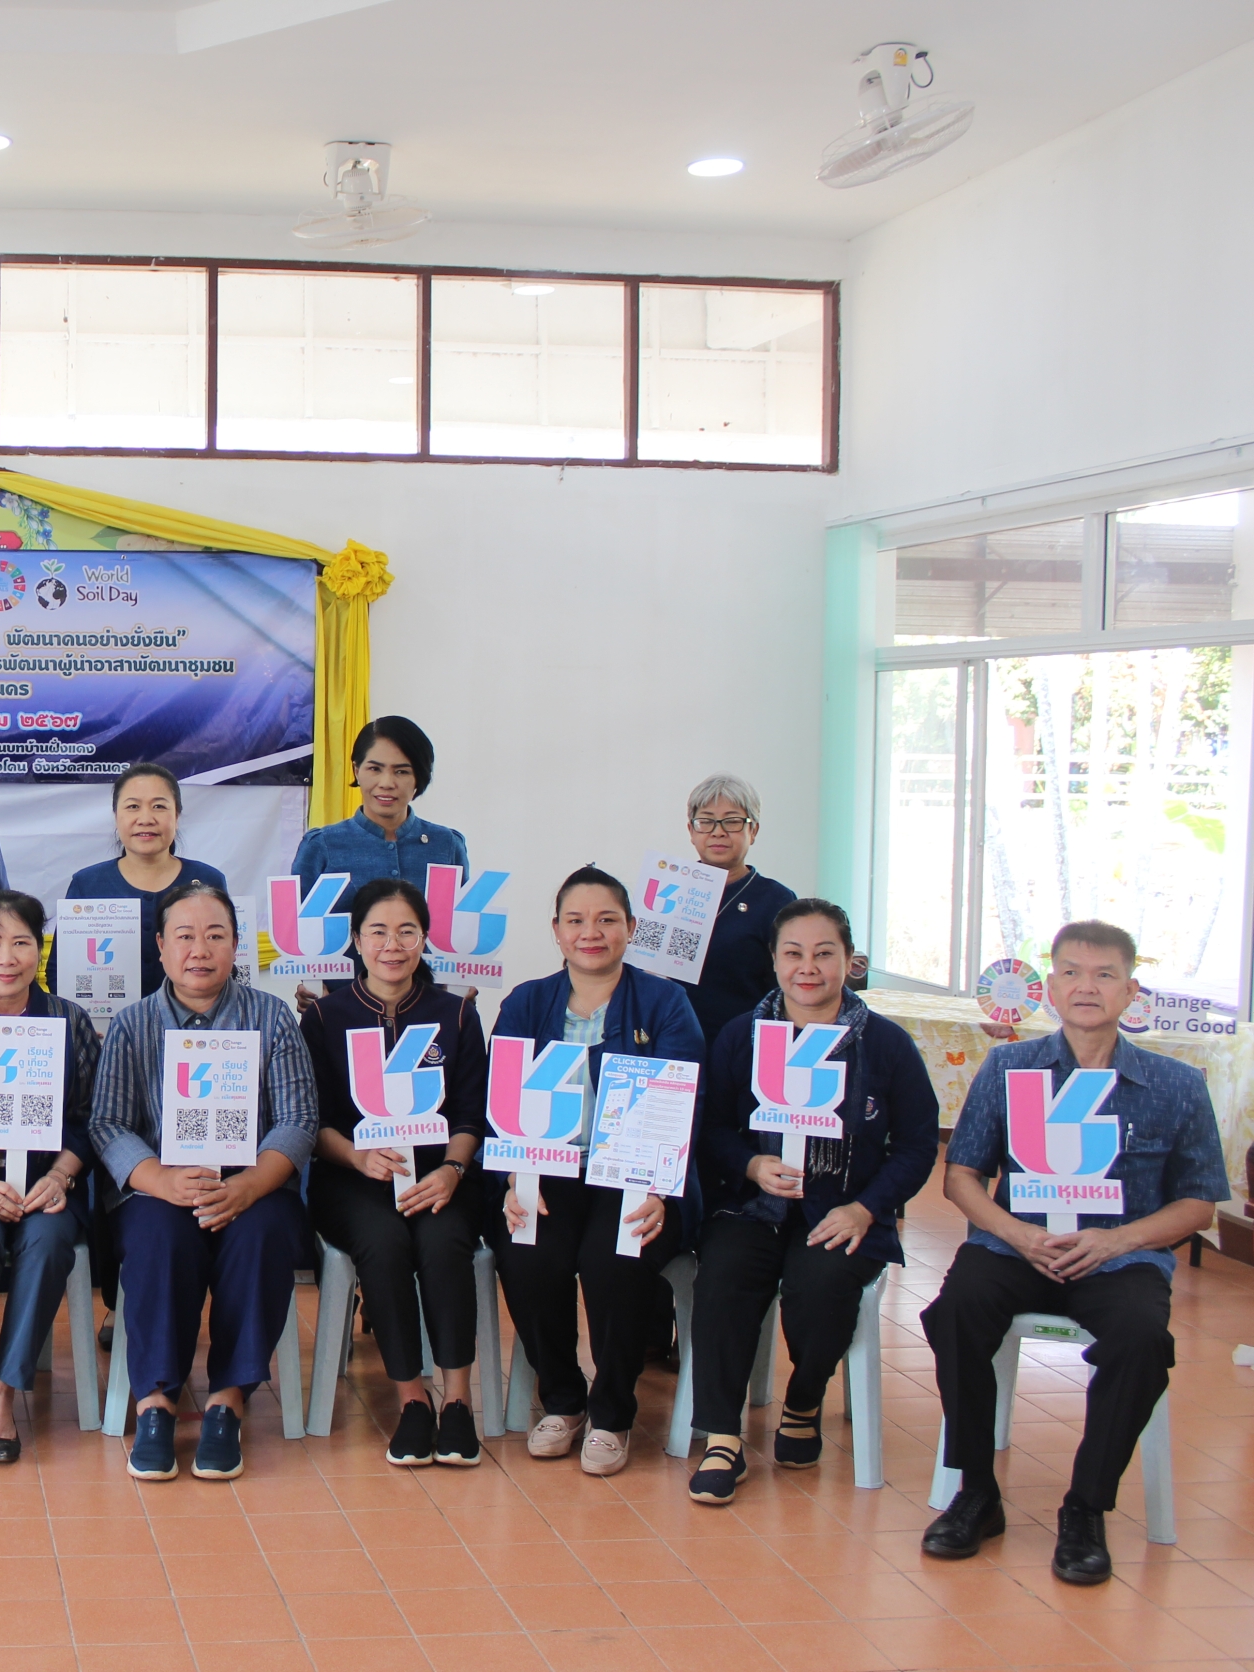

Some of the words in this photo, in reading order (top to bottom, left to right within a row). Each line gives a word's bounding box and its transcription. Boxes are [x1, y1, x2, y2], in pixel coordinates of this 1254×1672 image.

[83, 566, 130, 583] World
[77, 586, 105, 601] Soil
[109, 586, 138, 606] Day
[6, 626, 187, 648] พัฒนาคนอย่างยั่งยืน”
[20, 712, 80, 728] ๒๕๖๗
[687, 887, 712, 902] เรียนรู้
[273, 959, 352, 978] คลิกชุมชน
[1153, 1016, 1180, 1030] for
[1186, 1018, 1236, 1034] Good
[27, 1047, 54, 1058] เรียนรู้
[18, 1059, 24, 1068] ดู
[27, 1057, 48, 1067] เที่ยว
[222, 1060, 248, 1072] เรียนรู้
[612, 1057, 636, 1066] CLICK
[26, 1068, 53, 1078] ทั่วไทย
[212, 1073, 219, 1083] ดู
[222, 1069, 243, 1080] เที่ยว
[617, 1065, 657, 1076] CONNECT
[221, 1081, 248, 1092] ทั่วไทย
[755, 1108, 837, 1129] คลิกชุมชน
[358, 1121, 445, 1141] คลิกชุมชน
[486, 1139, 579, 1166] คลิกชุมชน
[1012, 1179, 1119, 1205] คลิกชุมชน
